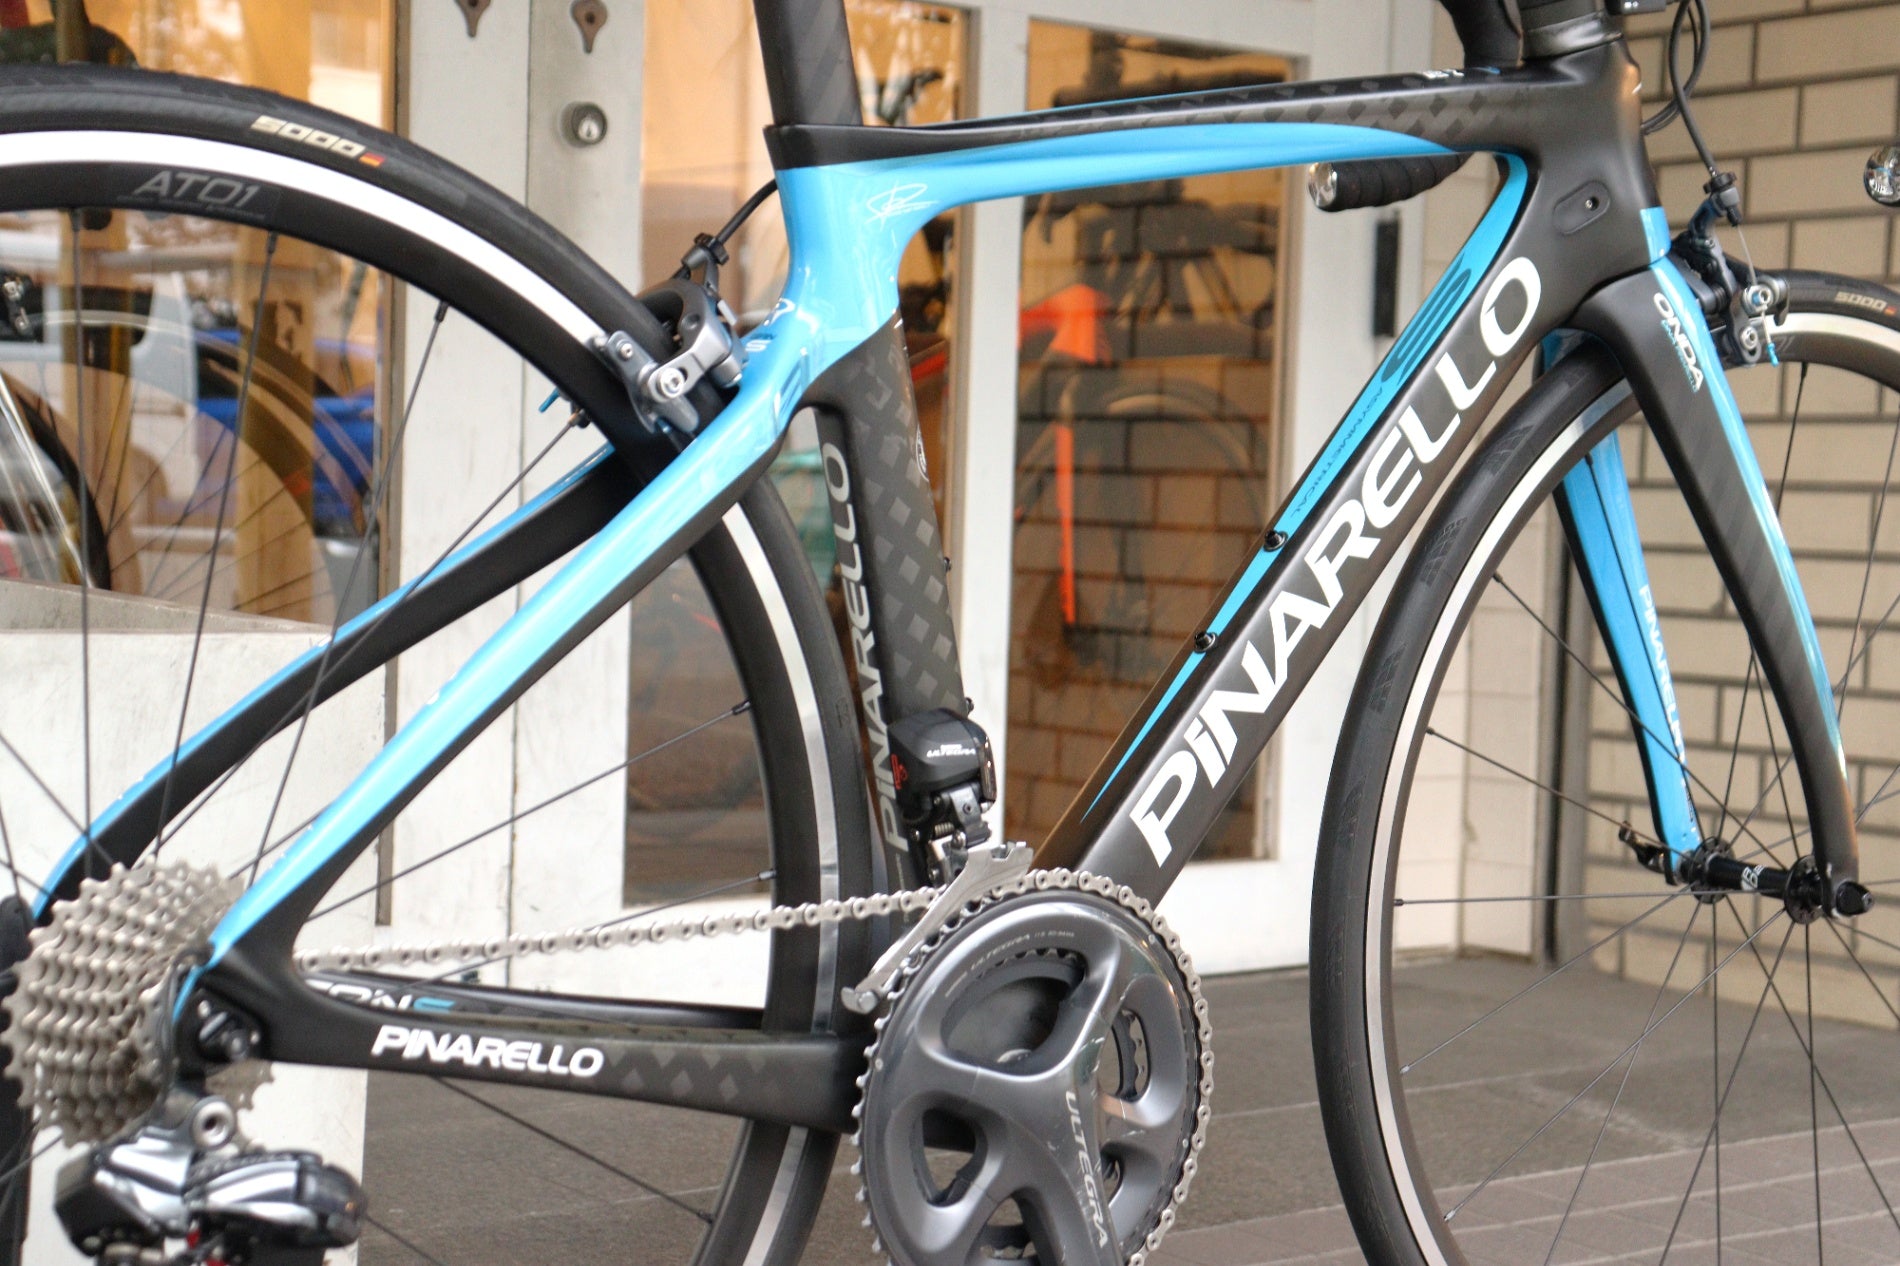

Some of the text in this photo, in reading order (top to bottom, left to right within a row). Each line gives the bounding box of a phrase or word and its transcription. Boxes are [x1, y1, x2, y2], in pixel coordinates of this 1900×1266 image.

[251, 115, 366, 158] 5000
[1653, 292, 1703, 390] ONDA
[1835, 291, 1887, 312] 5000
[1130, 257, 1541, 867] PINARELLO
[822, 443, 908, 847] PINARELLO
[371, 1024, 604, 1078] PINARELLO
[1066, 1091, 1108, 1248] ULTEGRA
